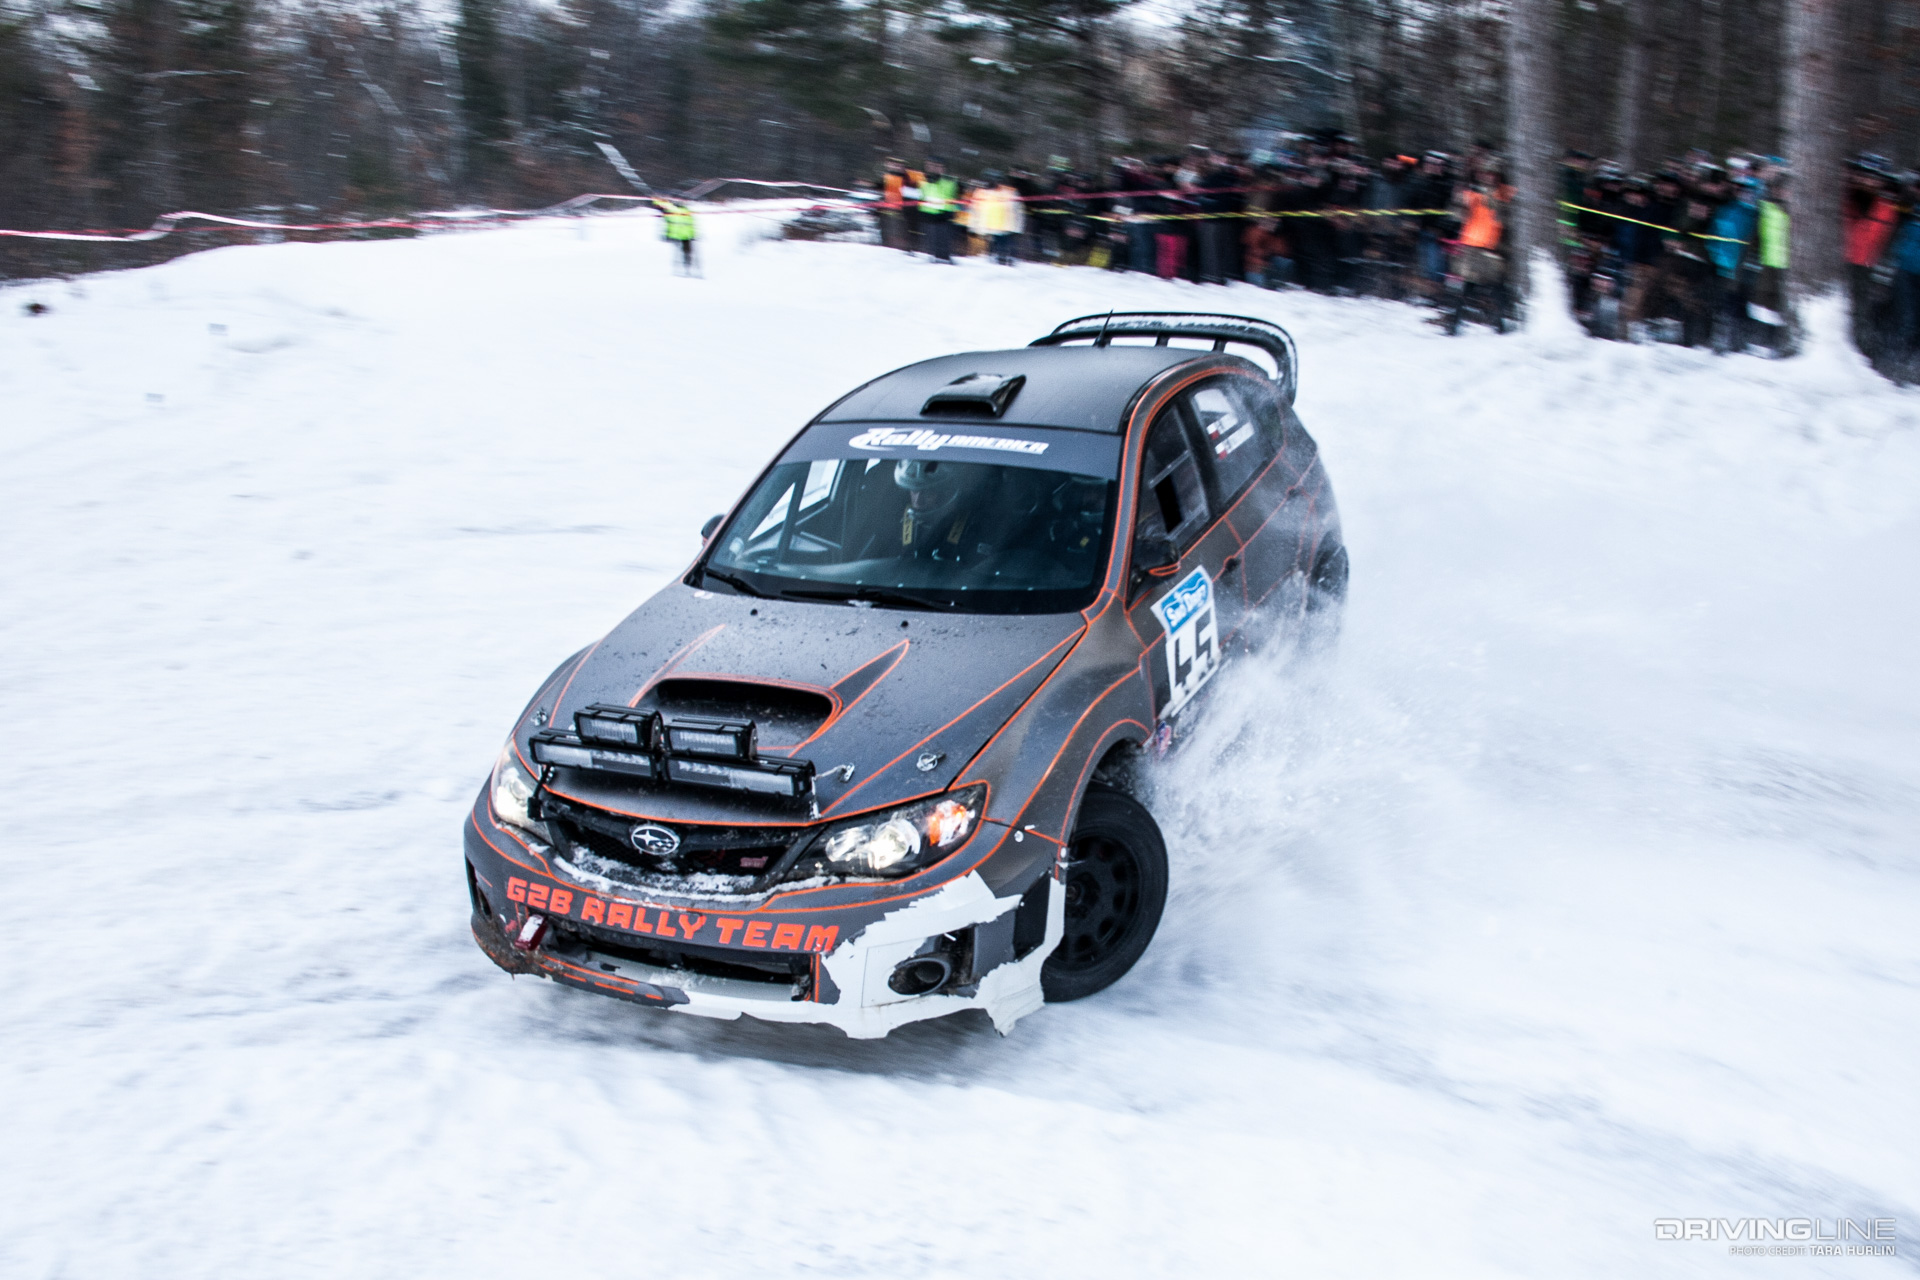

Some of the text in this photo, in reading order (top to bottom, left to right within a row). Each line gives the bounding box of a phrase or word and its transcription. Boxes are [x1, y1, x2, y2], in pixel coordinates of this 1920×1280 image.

[849, 428, 951, 451] Rally
[507, 876, 839, 952] G2B RALLY TEAM
